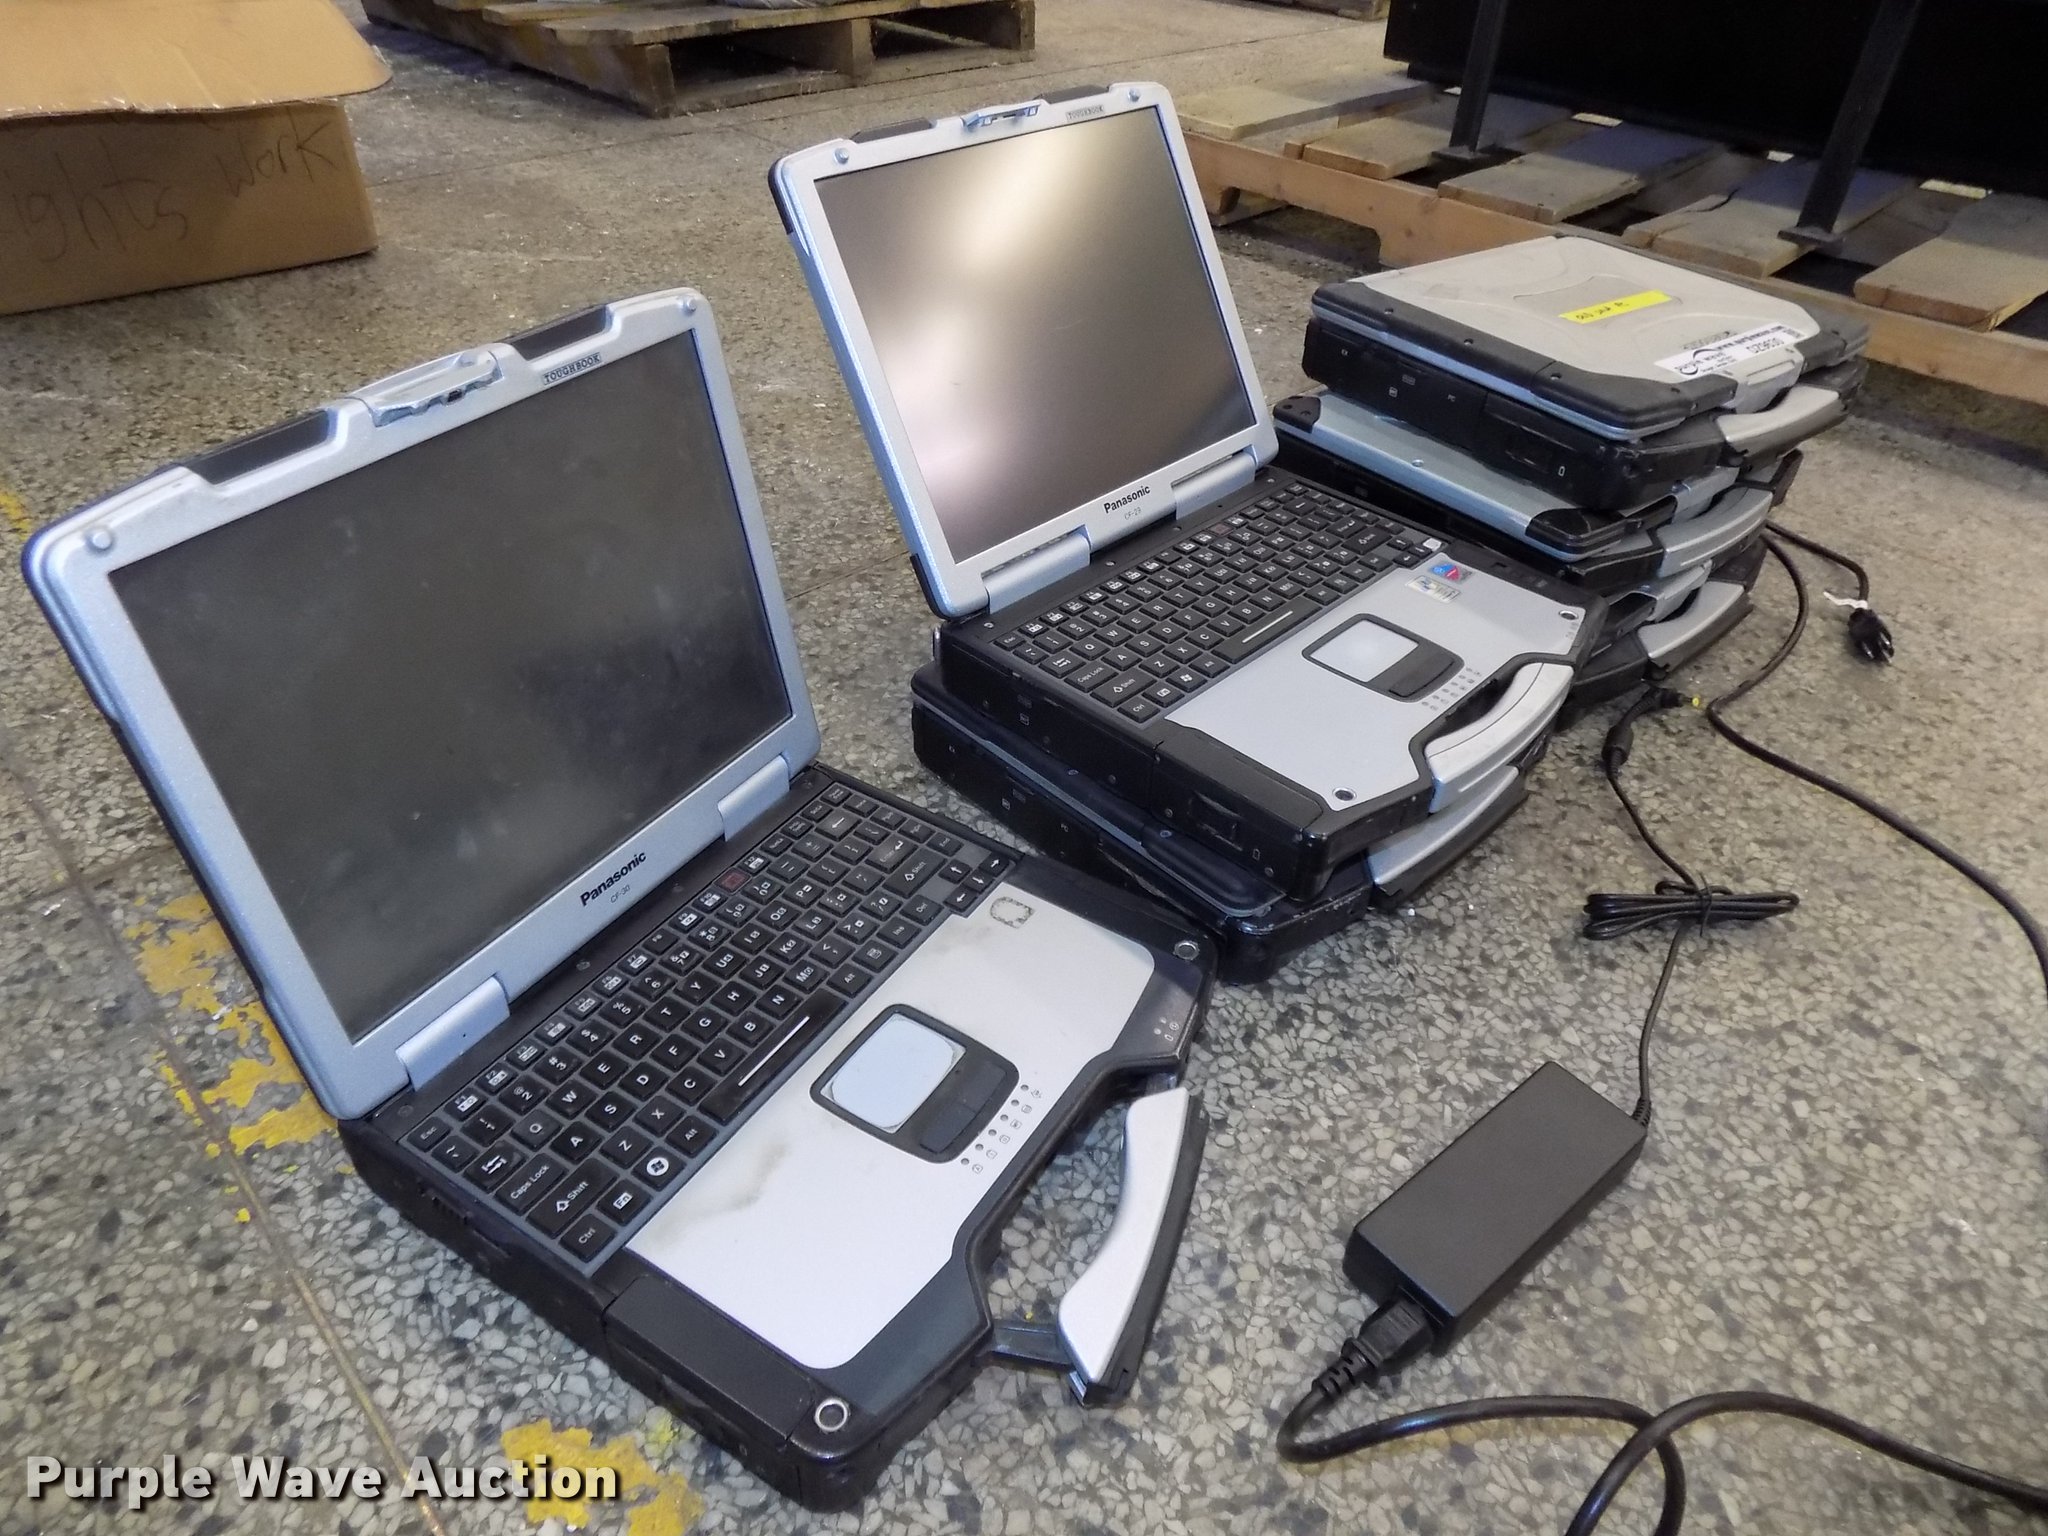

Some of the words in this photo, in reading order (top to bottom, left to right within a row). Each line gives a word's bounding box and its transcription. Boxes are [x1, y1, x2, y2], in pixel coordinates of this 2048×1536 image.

[0, 135, 188, 262] ights
[544, 353, 601, 384] TOUGHBOOK
[1103, 485, 1151, 514] Panasonic
[580, 852, 647, 907] Panasonic
[610, 884, 631, 903] CF-30
[510, 1180, 532, 1200] Caps
[529, 1164, 550, 1183] Lock
[567, 1180, 589, 1201] Shift
[578, 1227, 596, 1244] Ctrl
